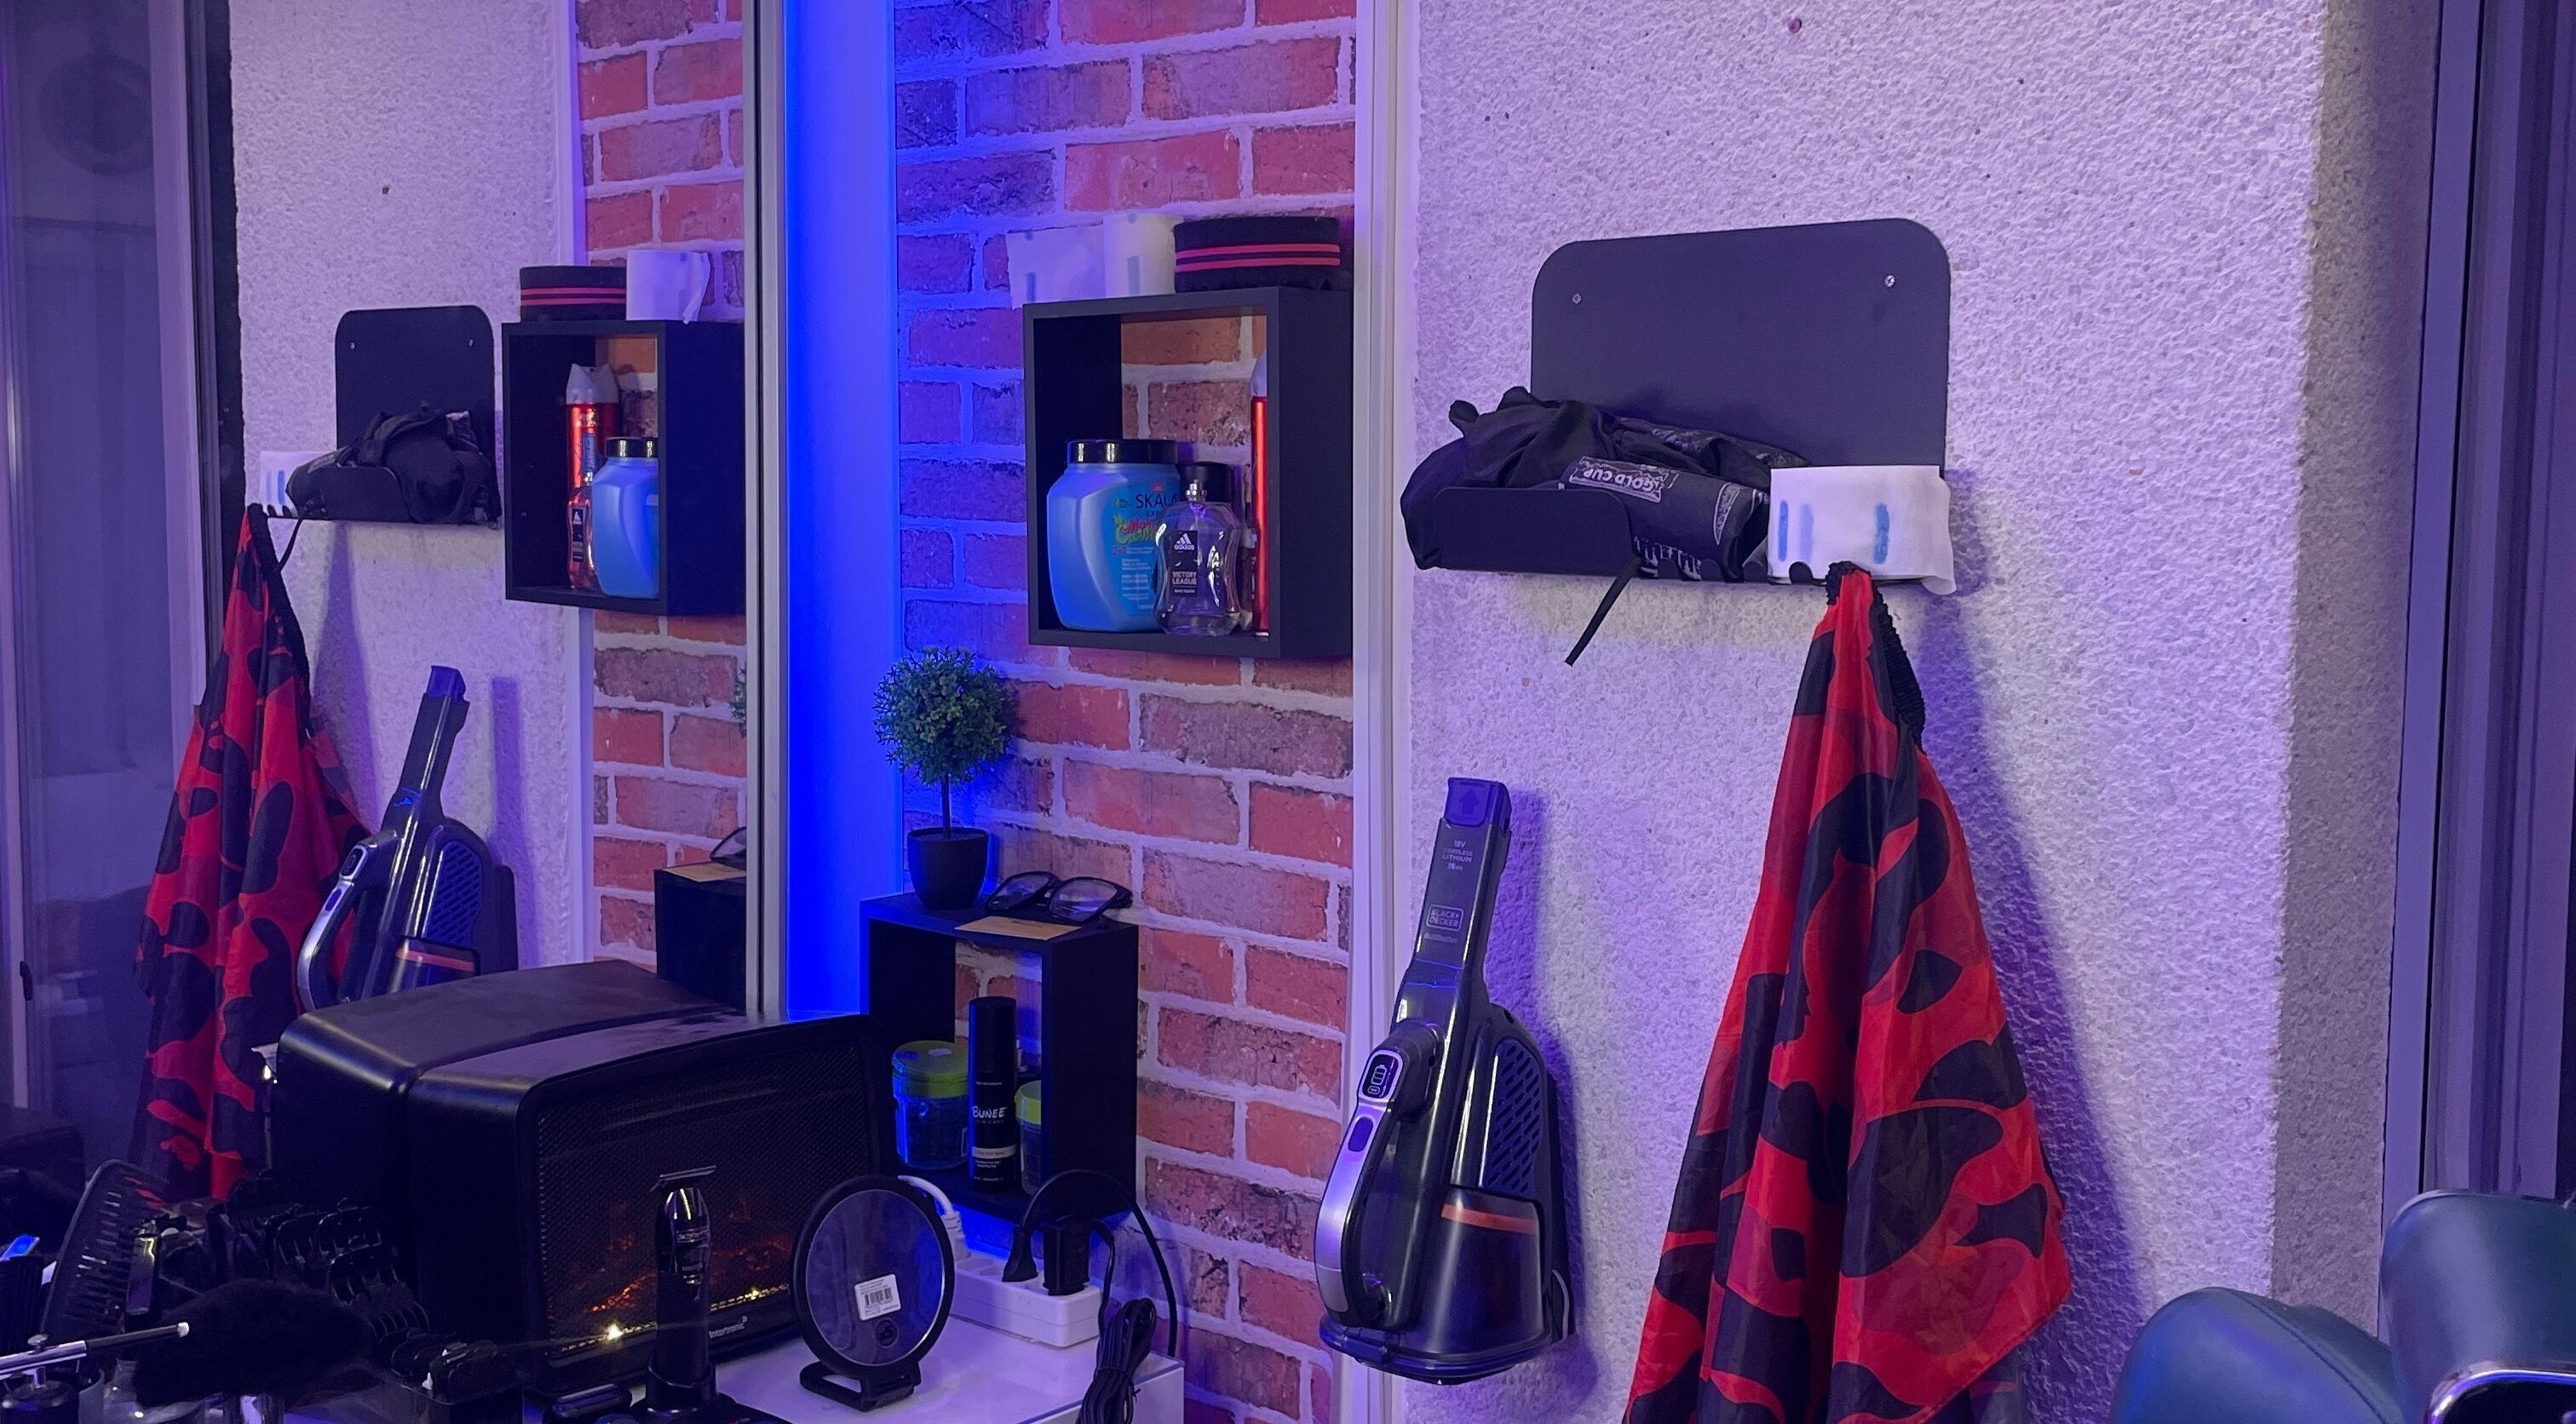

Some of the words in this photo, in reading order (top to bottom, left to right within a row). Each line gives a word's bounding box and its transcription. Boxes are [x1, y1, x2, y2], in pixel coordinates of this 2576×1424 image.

[1584, 468, 1613, 481] CUP
[1614, 474, 1653, 491] GOLD
[972, 1105, 1008, 1118] BUNEE
